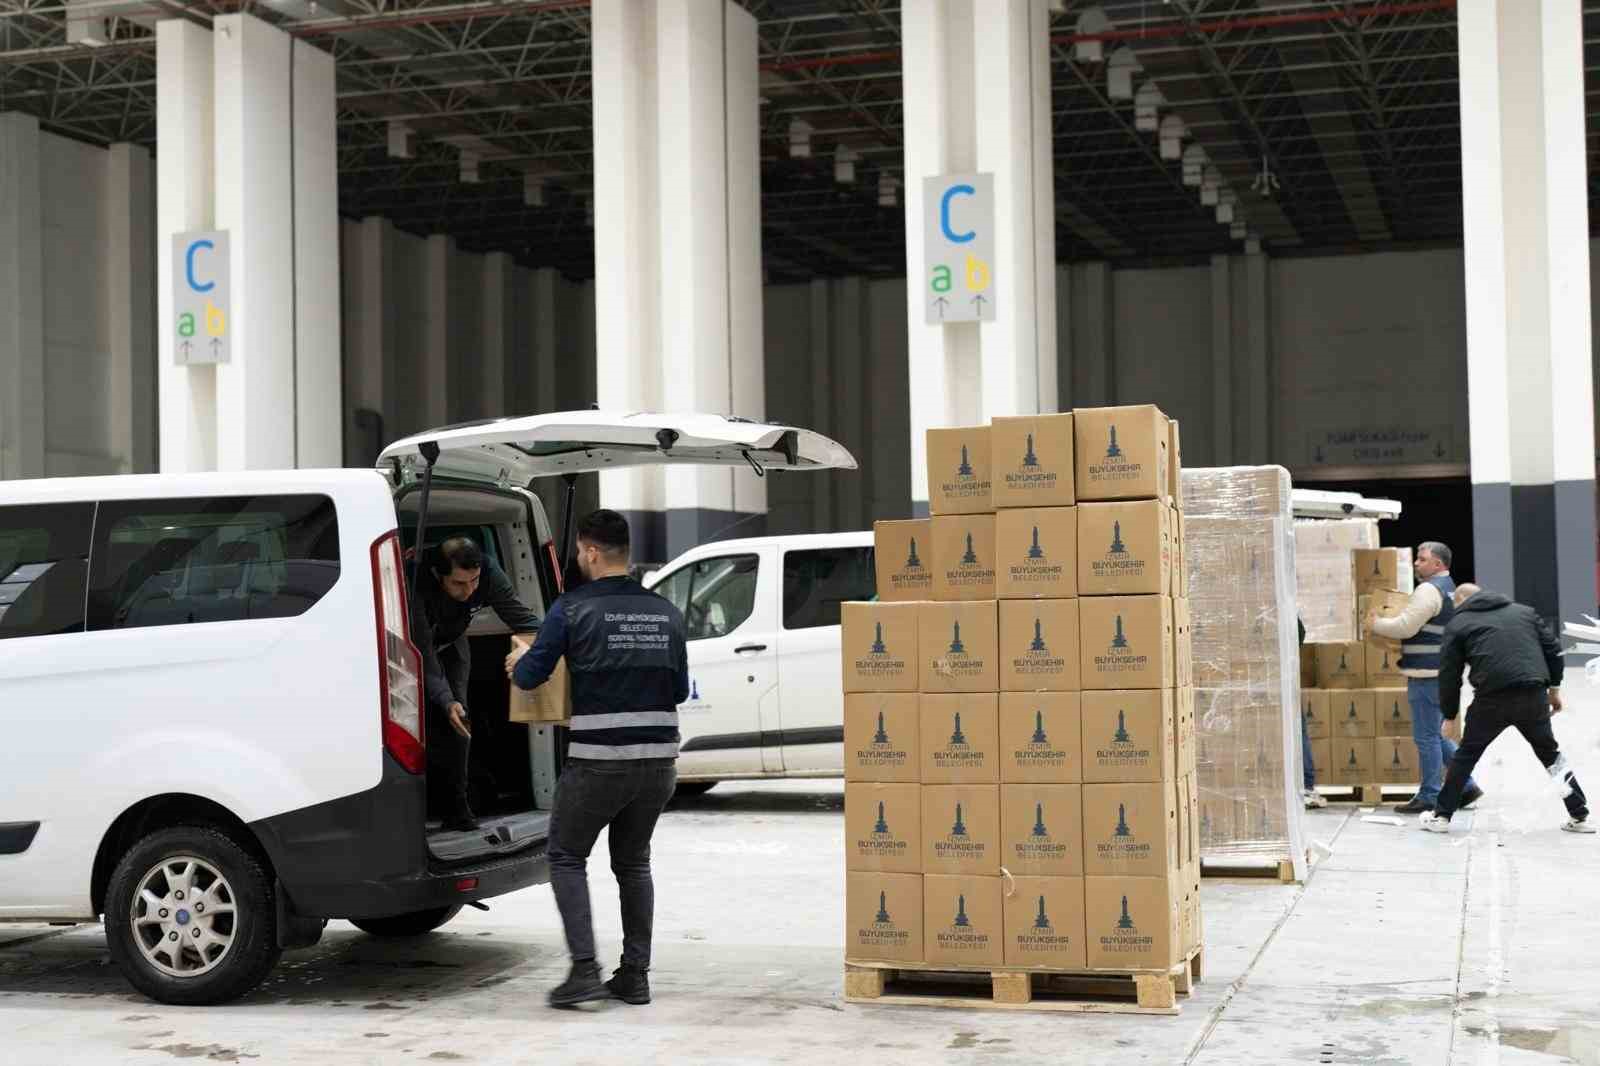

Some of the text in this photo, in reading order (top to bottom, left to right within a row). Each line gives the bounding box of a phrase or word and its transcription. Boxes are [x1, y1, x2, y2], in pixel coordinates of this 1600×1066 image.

[940, 184, 976, 244] C
[185, 240, 215, 292] C
[931, 254, 991, 292] a b
[178, 299, 225, 337] a b
